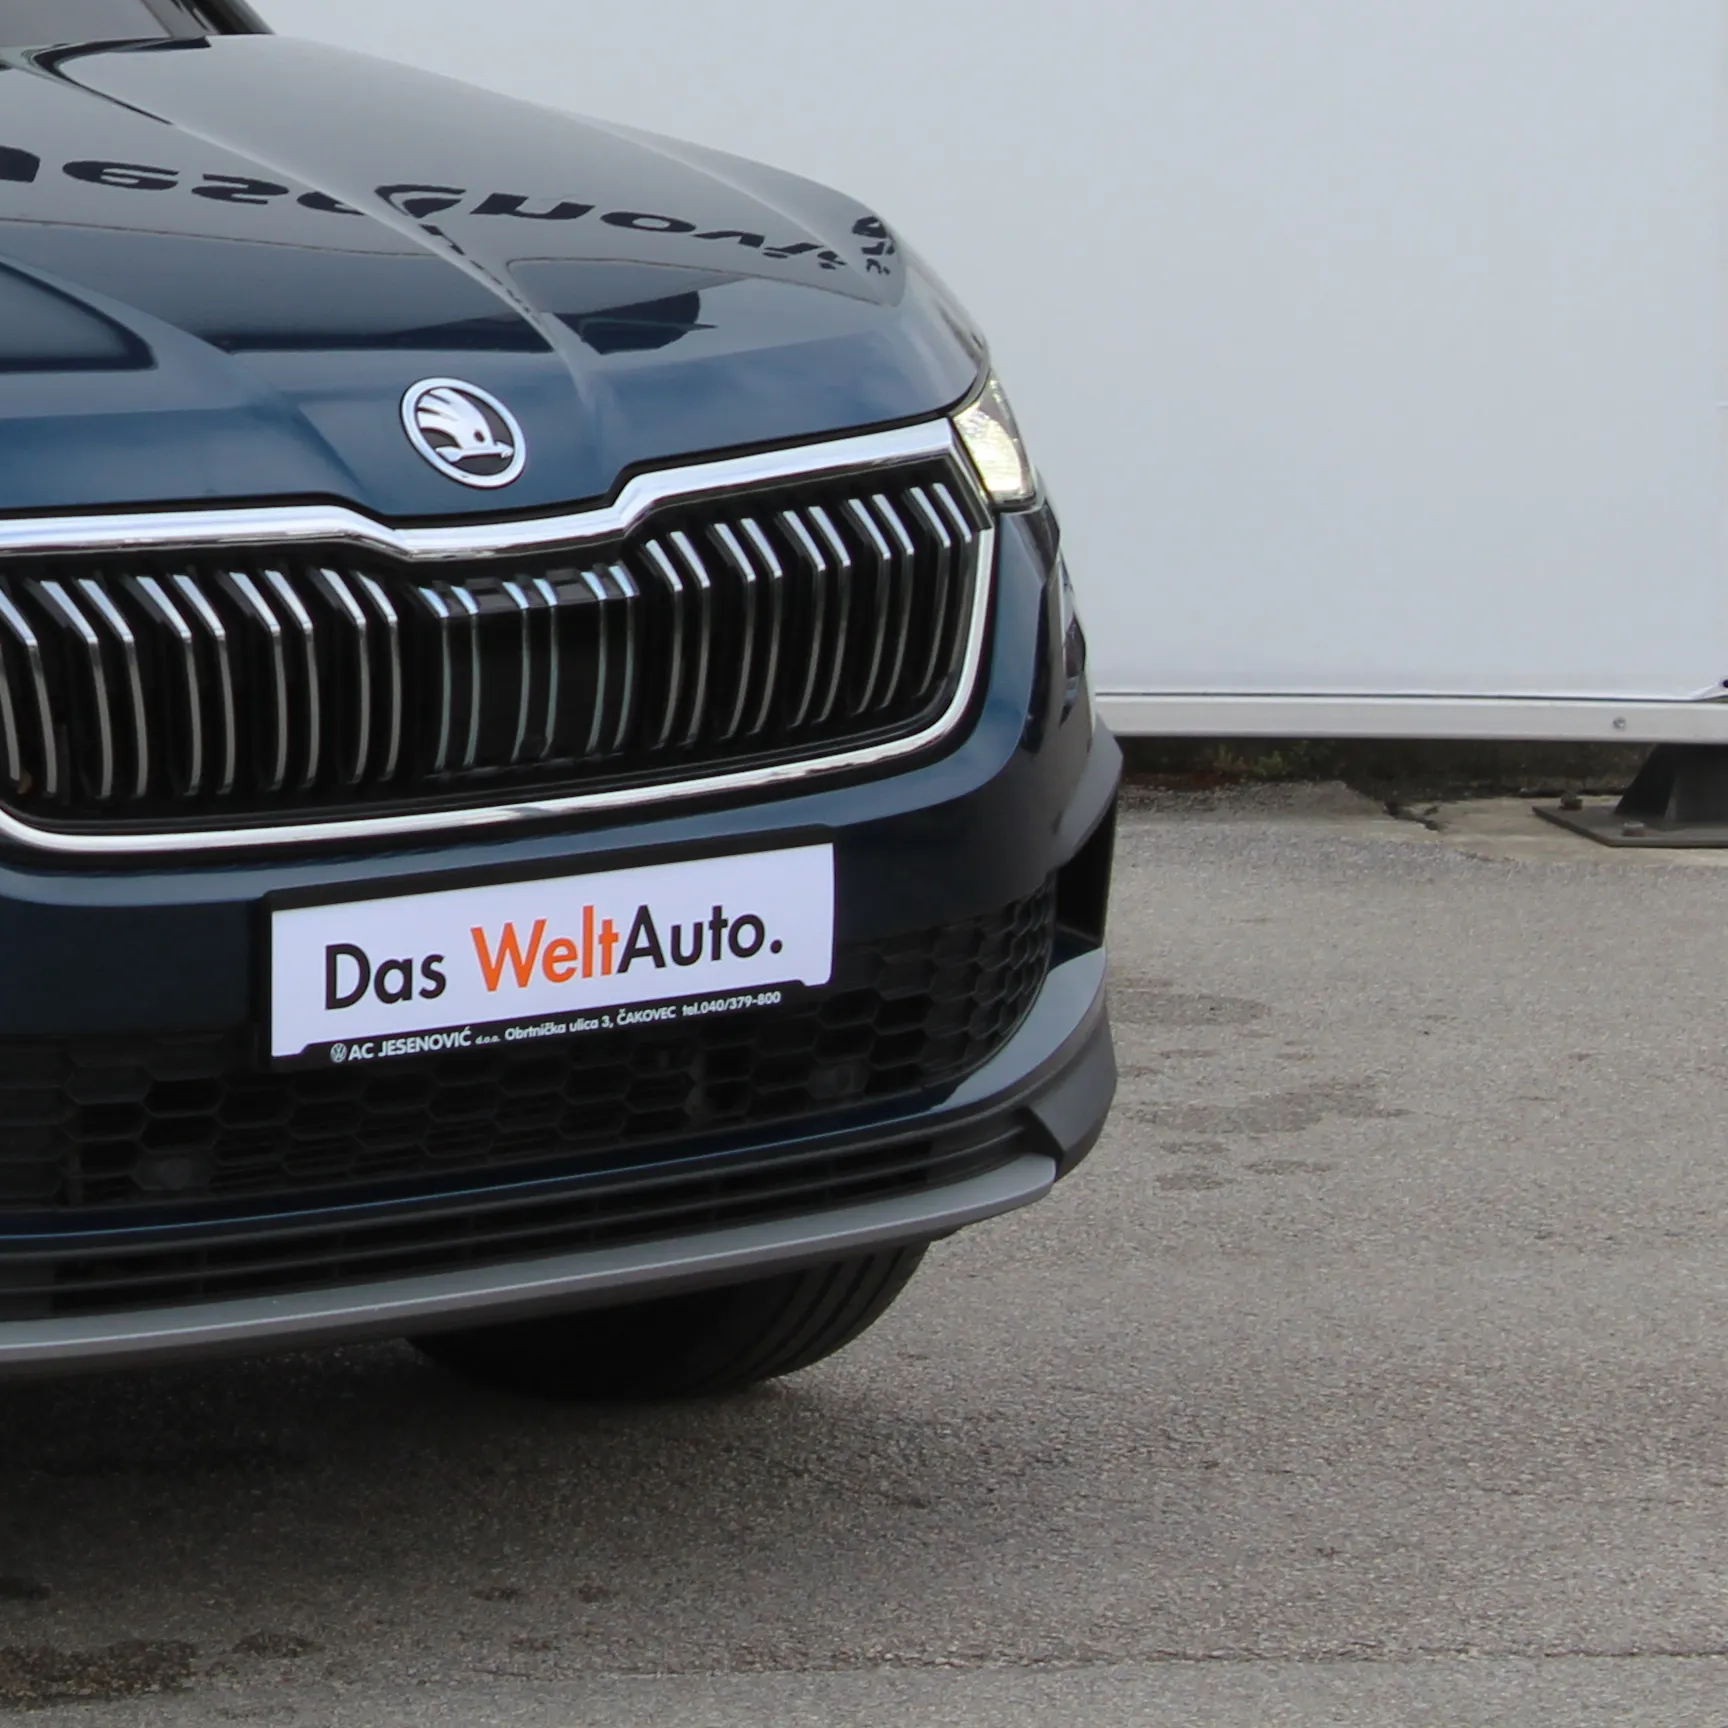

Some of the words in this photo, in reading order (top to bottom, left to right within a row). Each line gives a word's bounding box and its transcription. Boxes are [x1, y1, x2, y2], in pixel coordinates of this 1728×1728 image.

[324, 943, 446, 1010] Das
[471, 905, 783, 992] WeltAuto.
[348, 1042, 374, 1061] AC
[378, 1026, 472, 1057] JESENOVIĆ
[505, 1021, 566, 1041] Obrtnička
[569, 1017, 599, 1033] ulica
[616, 1005, 677, 1026] ČAKOVEC
